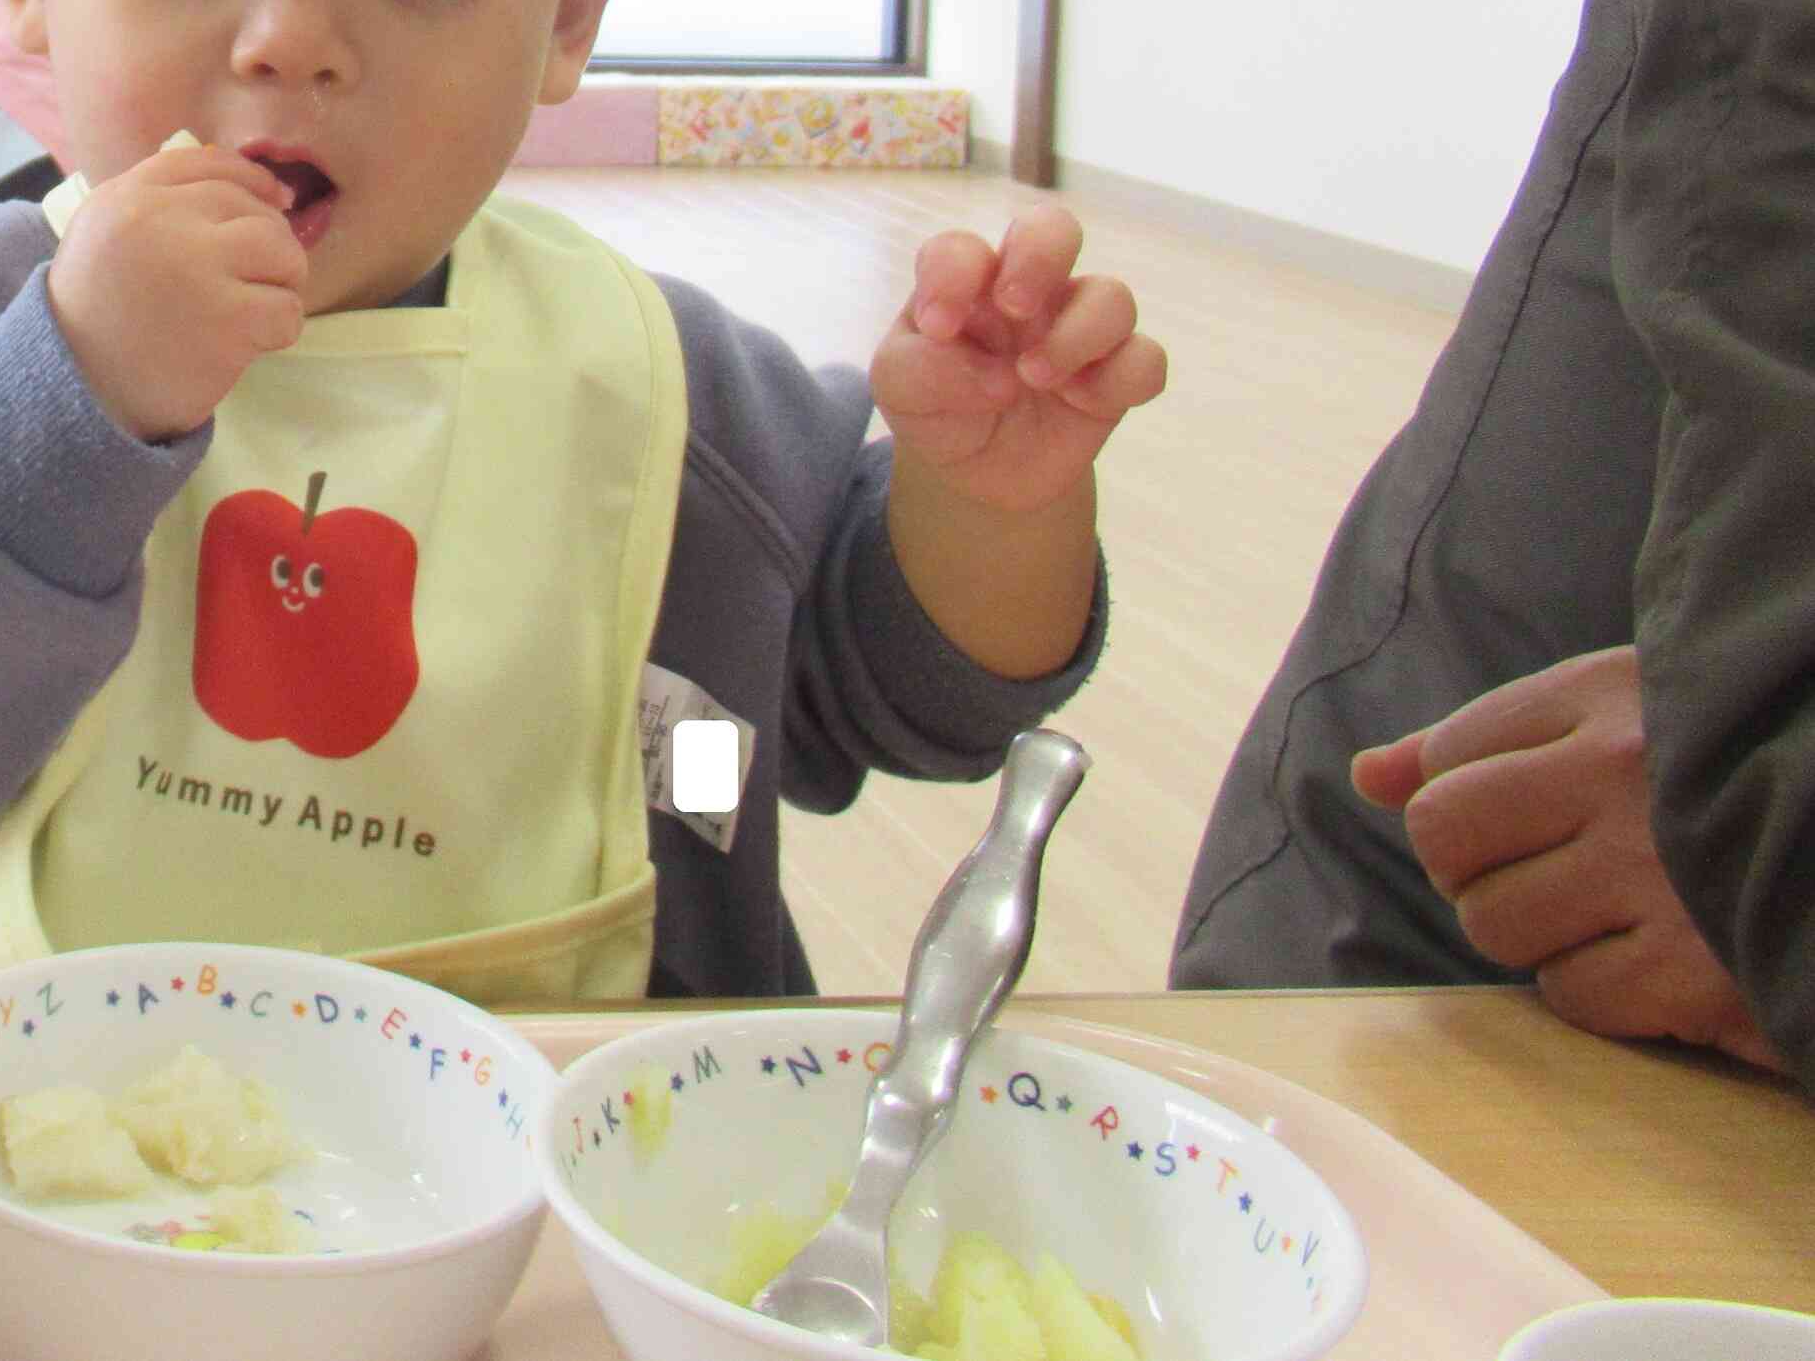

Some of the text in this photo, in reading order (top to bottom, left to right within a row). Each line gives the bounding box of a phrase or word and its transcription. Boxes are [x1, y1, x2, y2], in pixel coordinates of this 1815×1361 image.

[135, 755, 436, 857] Yummy Apple
[37, 982, 64, 1017] Z
[138, 983, 160, 1015] A
[197, 963, 218, 995] B
[250, 990, 273, 1018] C
[314, 993, 339, 1024] D
[380, 1007, 408, 1040] E
[430, 1048, 447, 1081] F
[474, 1056, 491, 1085] G
[601, 1096, 620, 1134] K
[692, 1045, 722, 1083] M
[786, 1046, 823, 1088] N
[1008, 1072, 1047, 1111] Q
[1090, 1105, 1119, 1141] R
[1154, 1141, 1177, 1177] S
[1217, 1157, 1239, 1194] T
